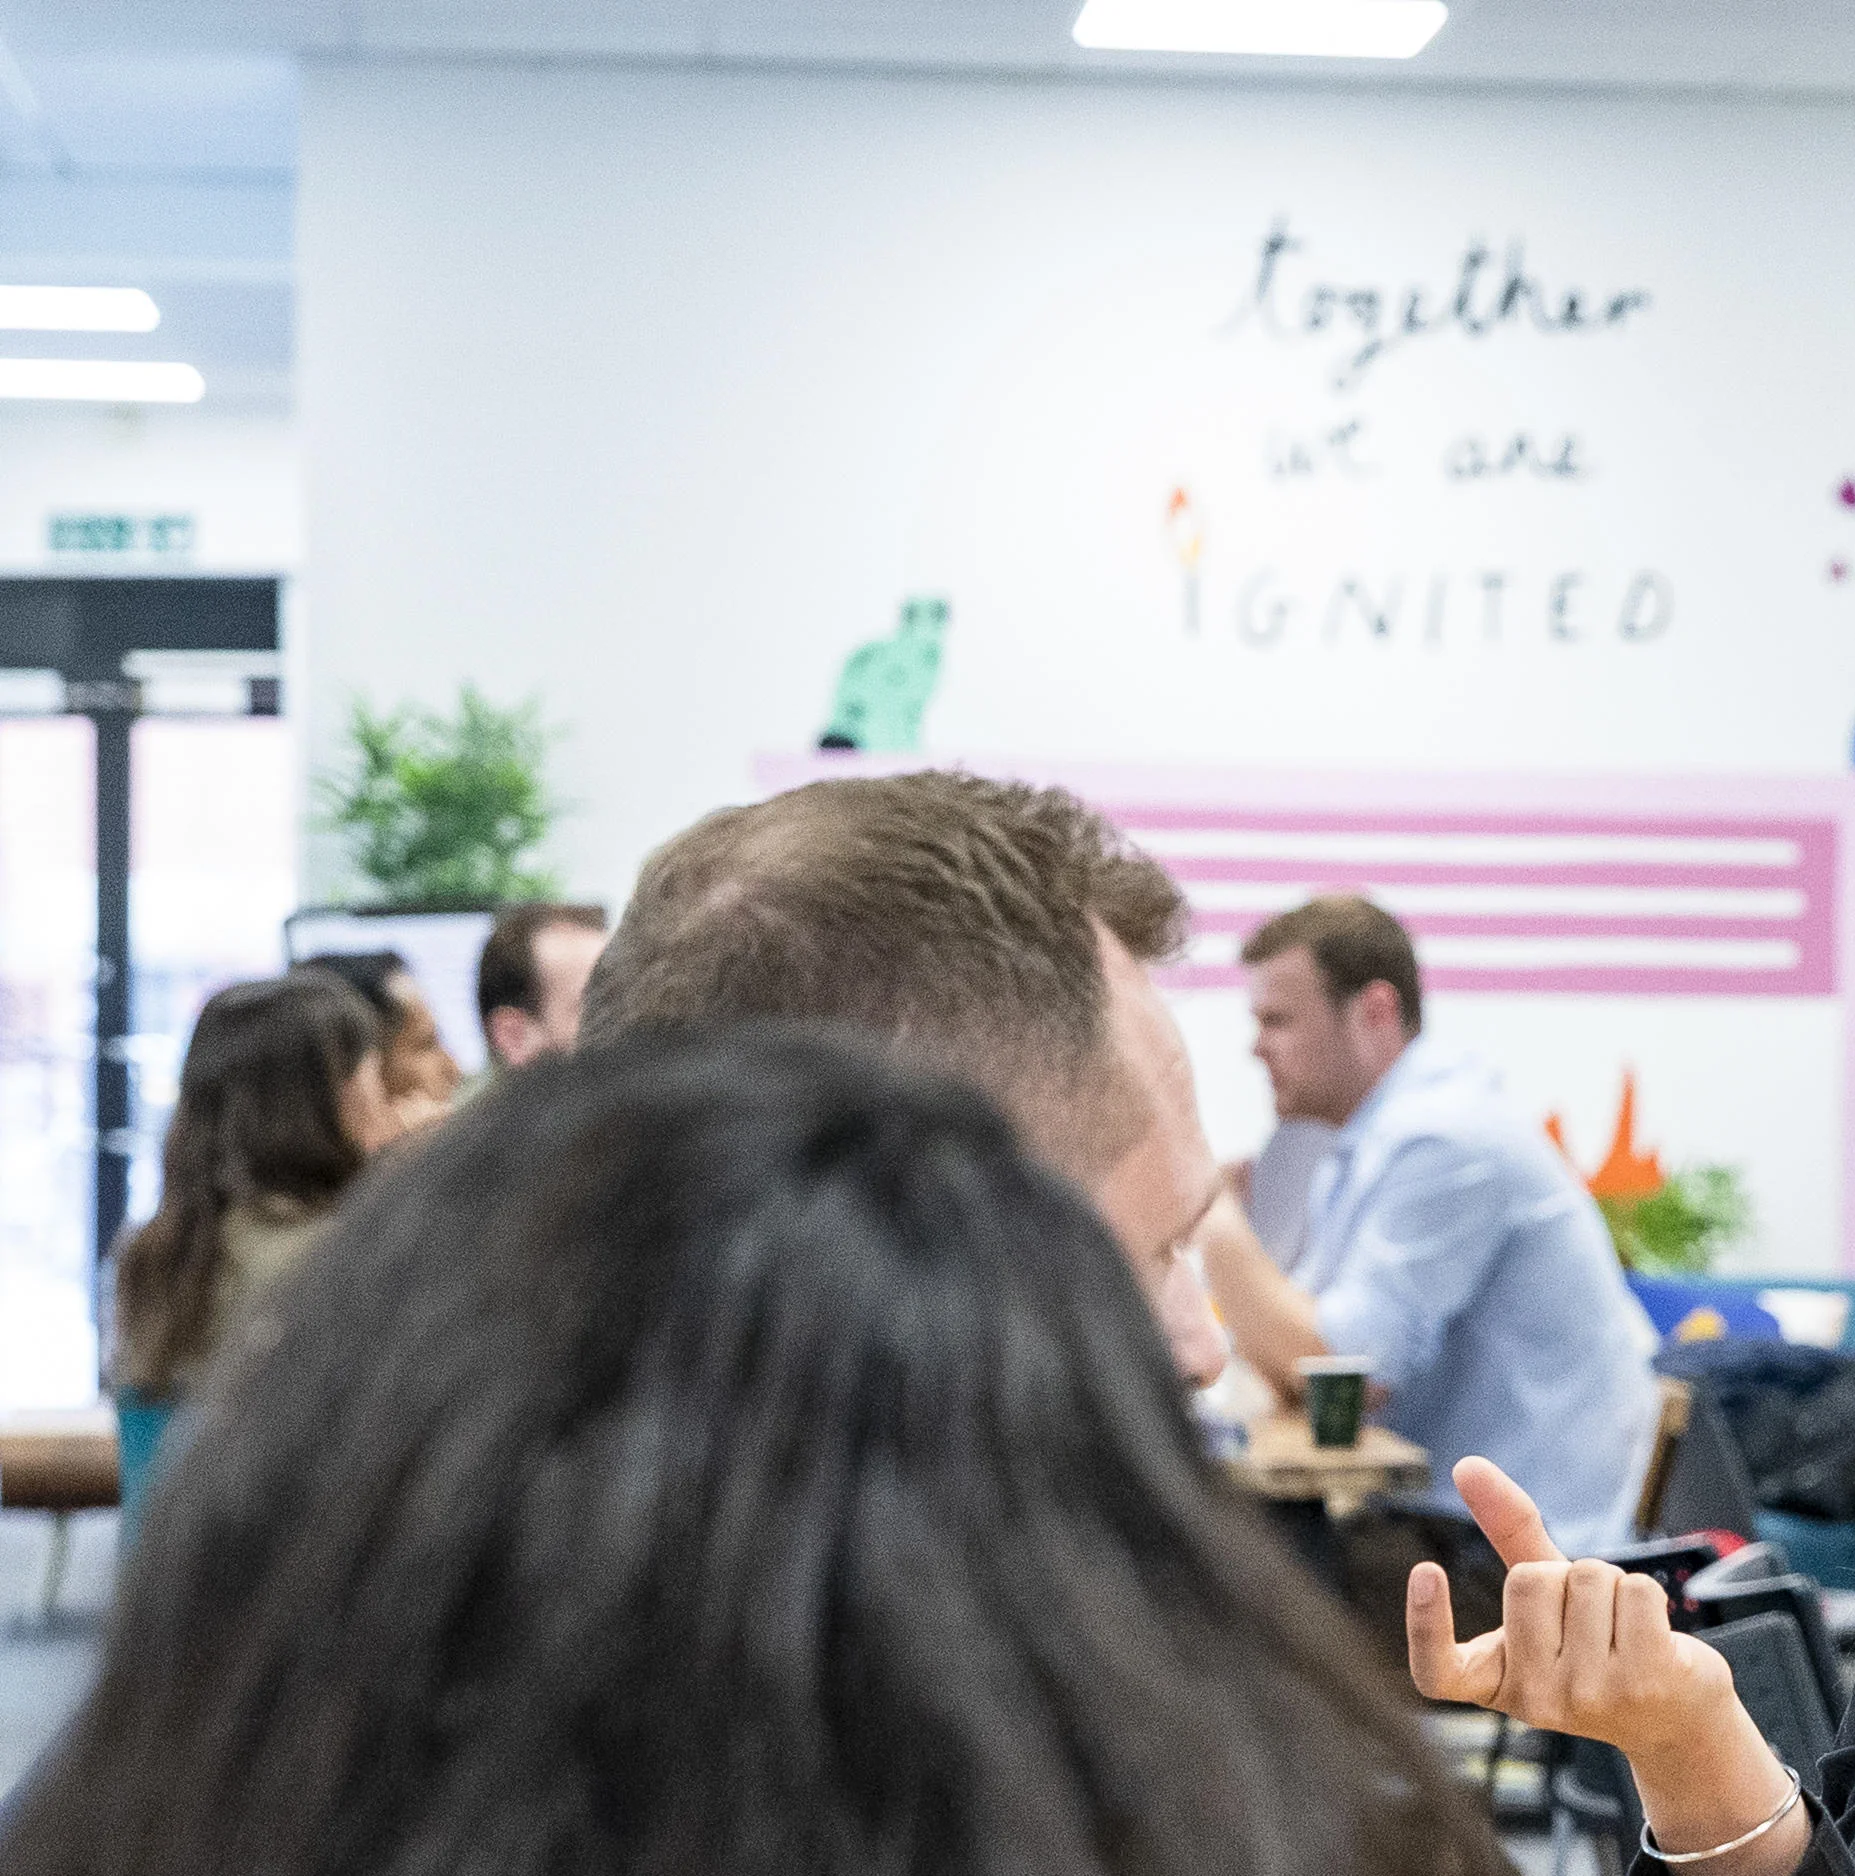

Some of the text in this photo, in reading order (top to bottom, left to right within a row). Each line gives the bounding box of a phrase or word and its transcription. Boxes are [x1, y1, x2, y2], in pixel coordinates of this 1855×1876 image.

[1216, 213, 1653, 390] together
[1266, 416, 1594, 483] we are
[1178, 567, 1675, 648] IGNITED
